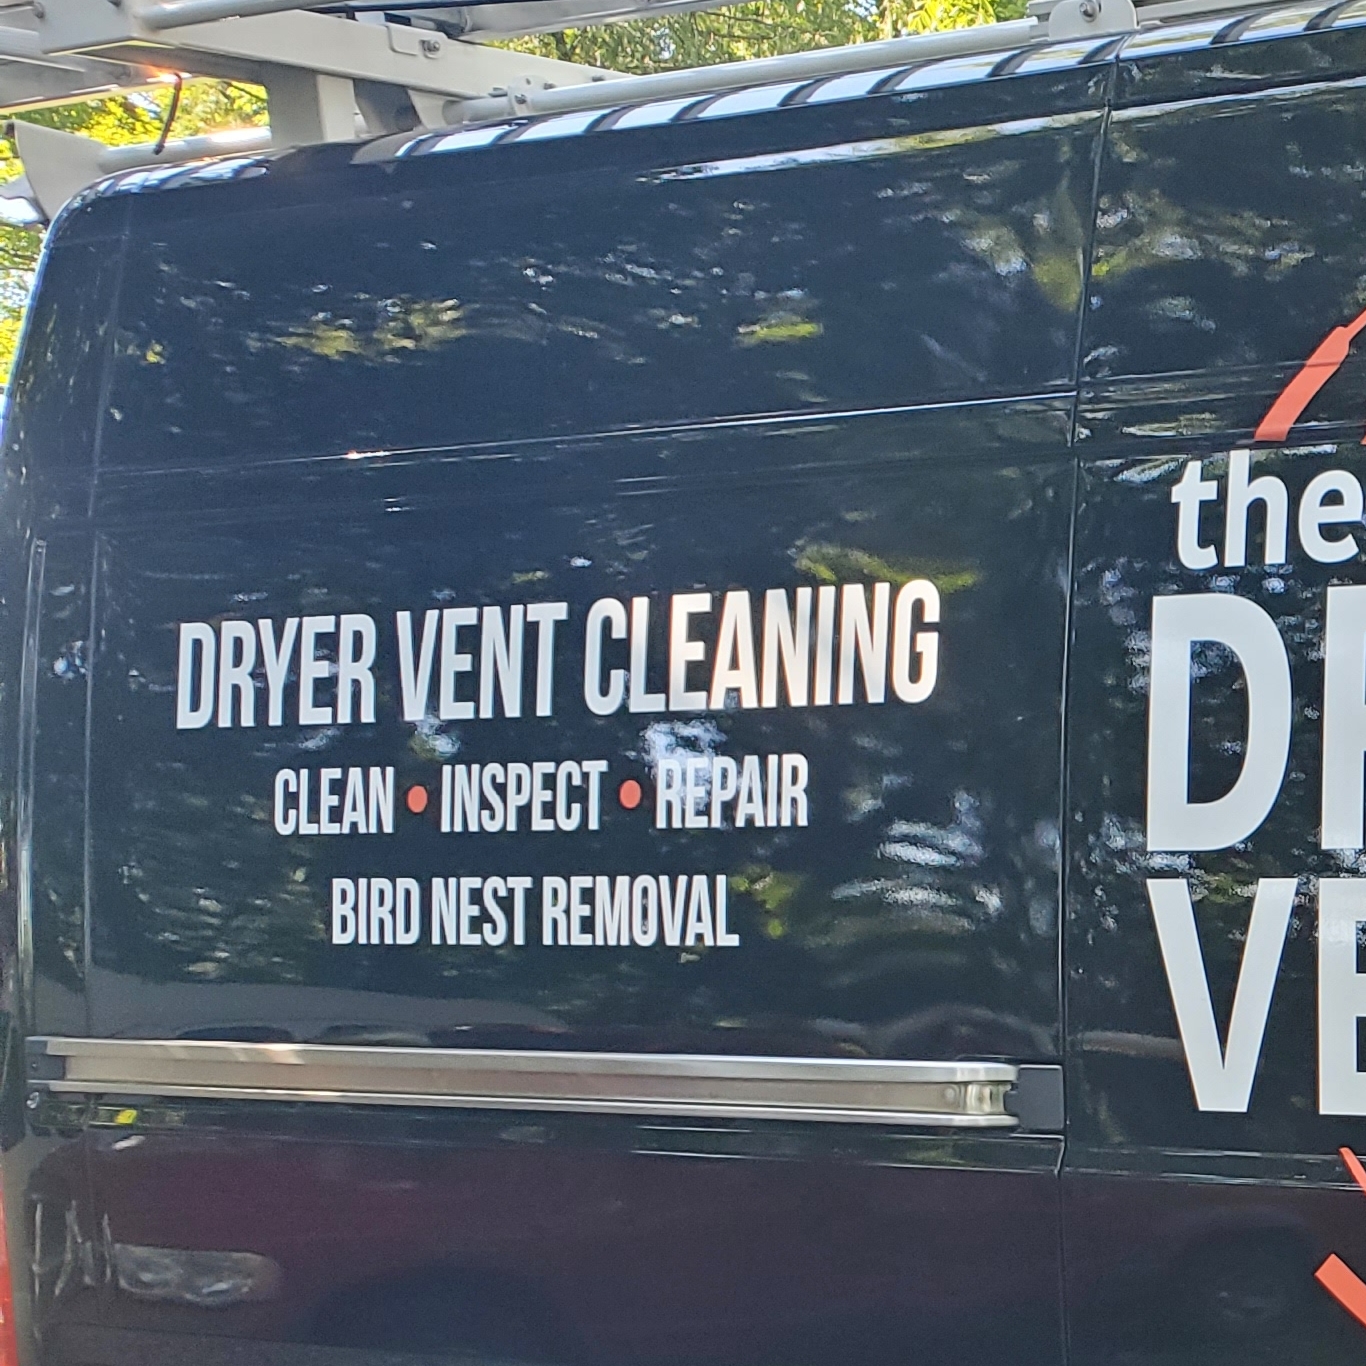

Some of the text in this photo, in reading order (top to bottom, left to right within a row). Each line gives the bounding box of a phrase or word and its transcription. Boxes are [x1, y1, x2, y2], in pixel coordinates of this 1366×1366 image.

[1171, 449, 1364, 571] the
[176, 579, 941, 730] DRYER VENT CLEANING
[273, 753, 809, 836] CLEAN INSPECT REPAIR
[331, 874, 740, 947] BIRD NEST REMOVAL
